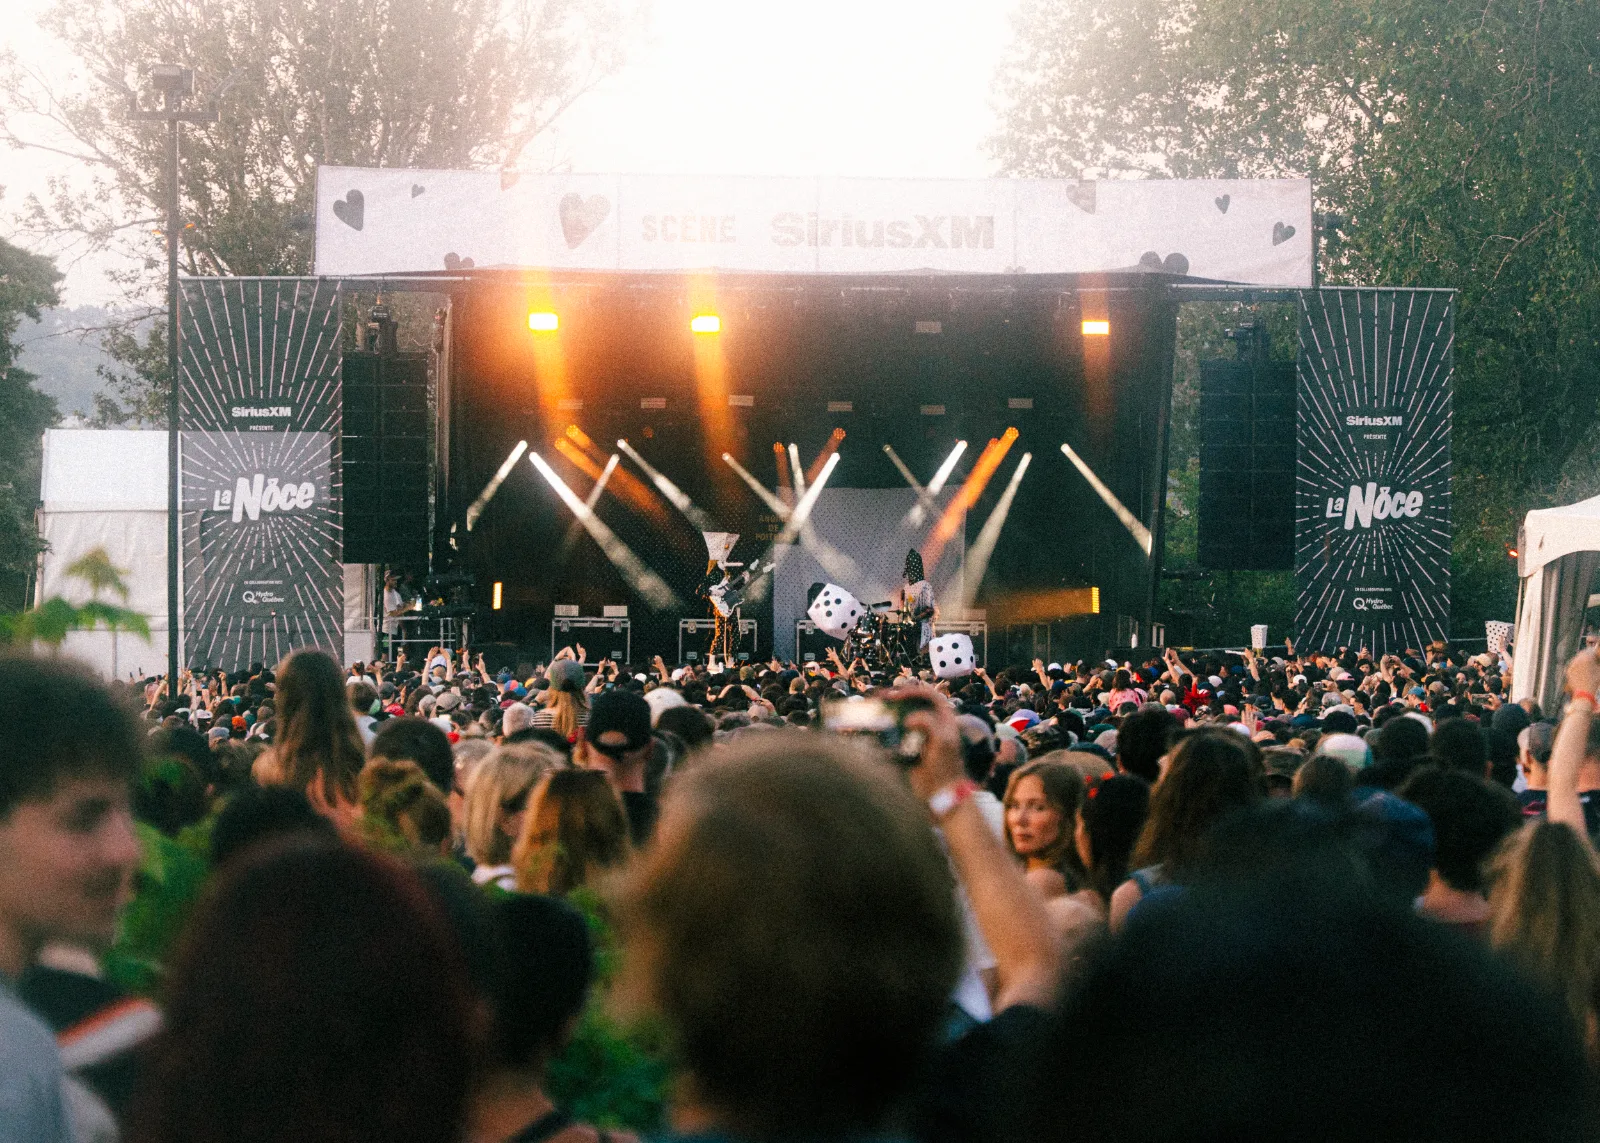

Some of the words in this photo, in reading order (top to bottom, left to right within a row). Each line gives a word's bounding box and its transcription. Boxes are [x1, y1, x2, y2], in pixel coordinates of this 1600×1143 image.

[769, 211, 995, 250] SiriusXM
[231, 406, 292, 418] SiriusXM
[1346, 415, 1403, 427] SiriusXM
